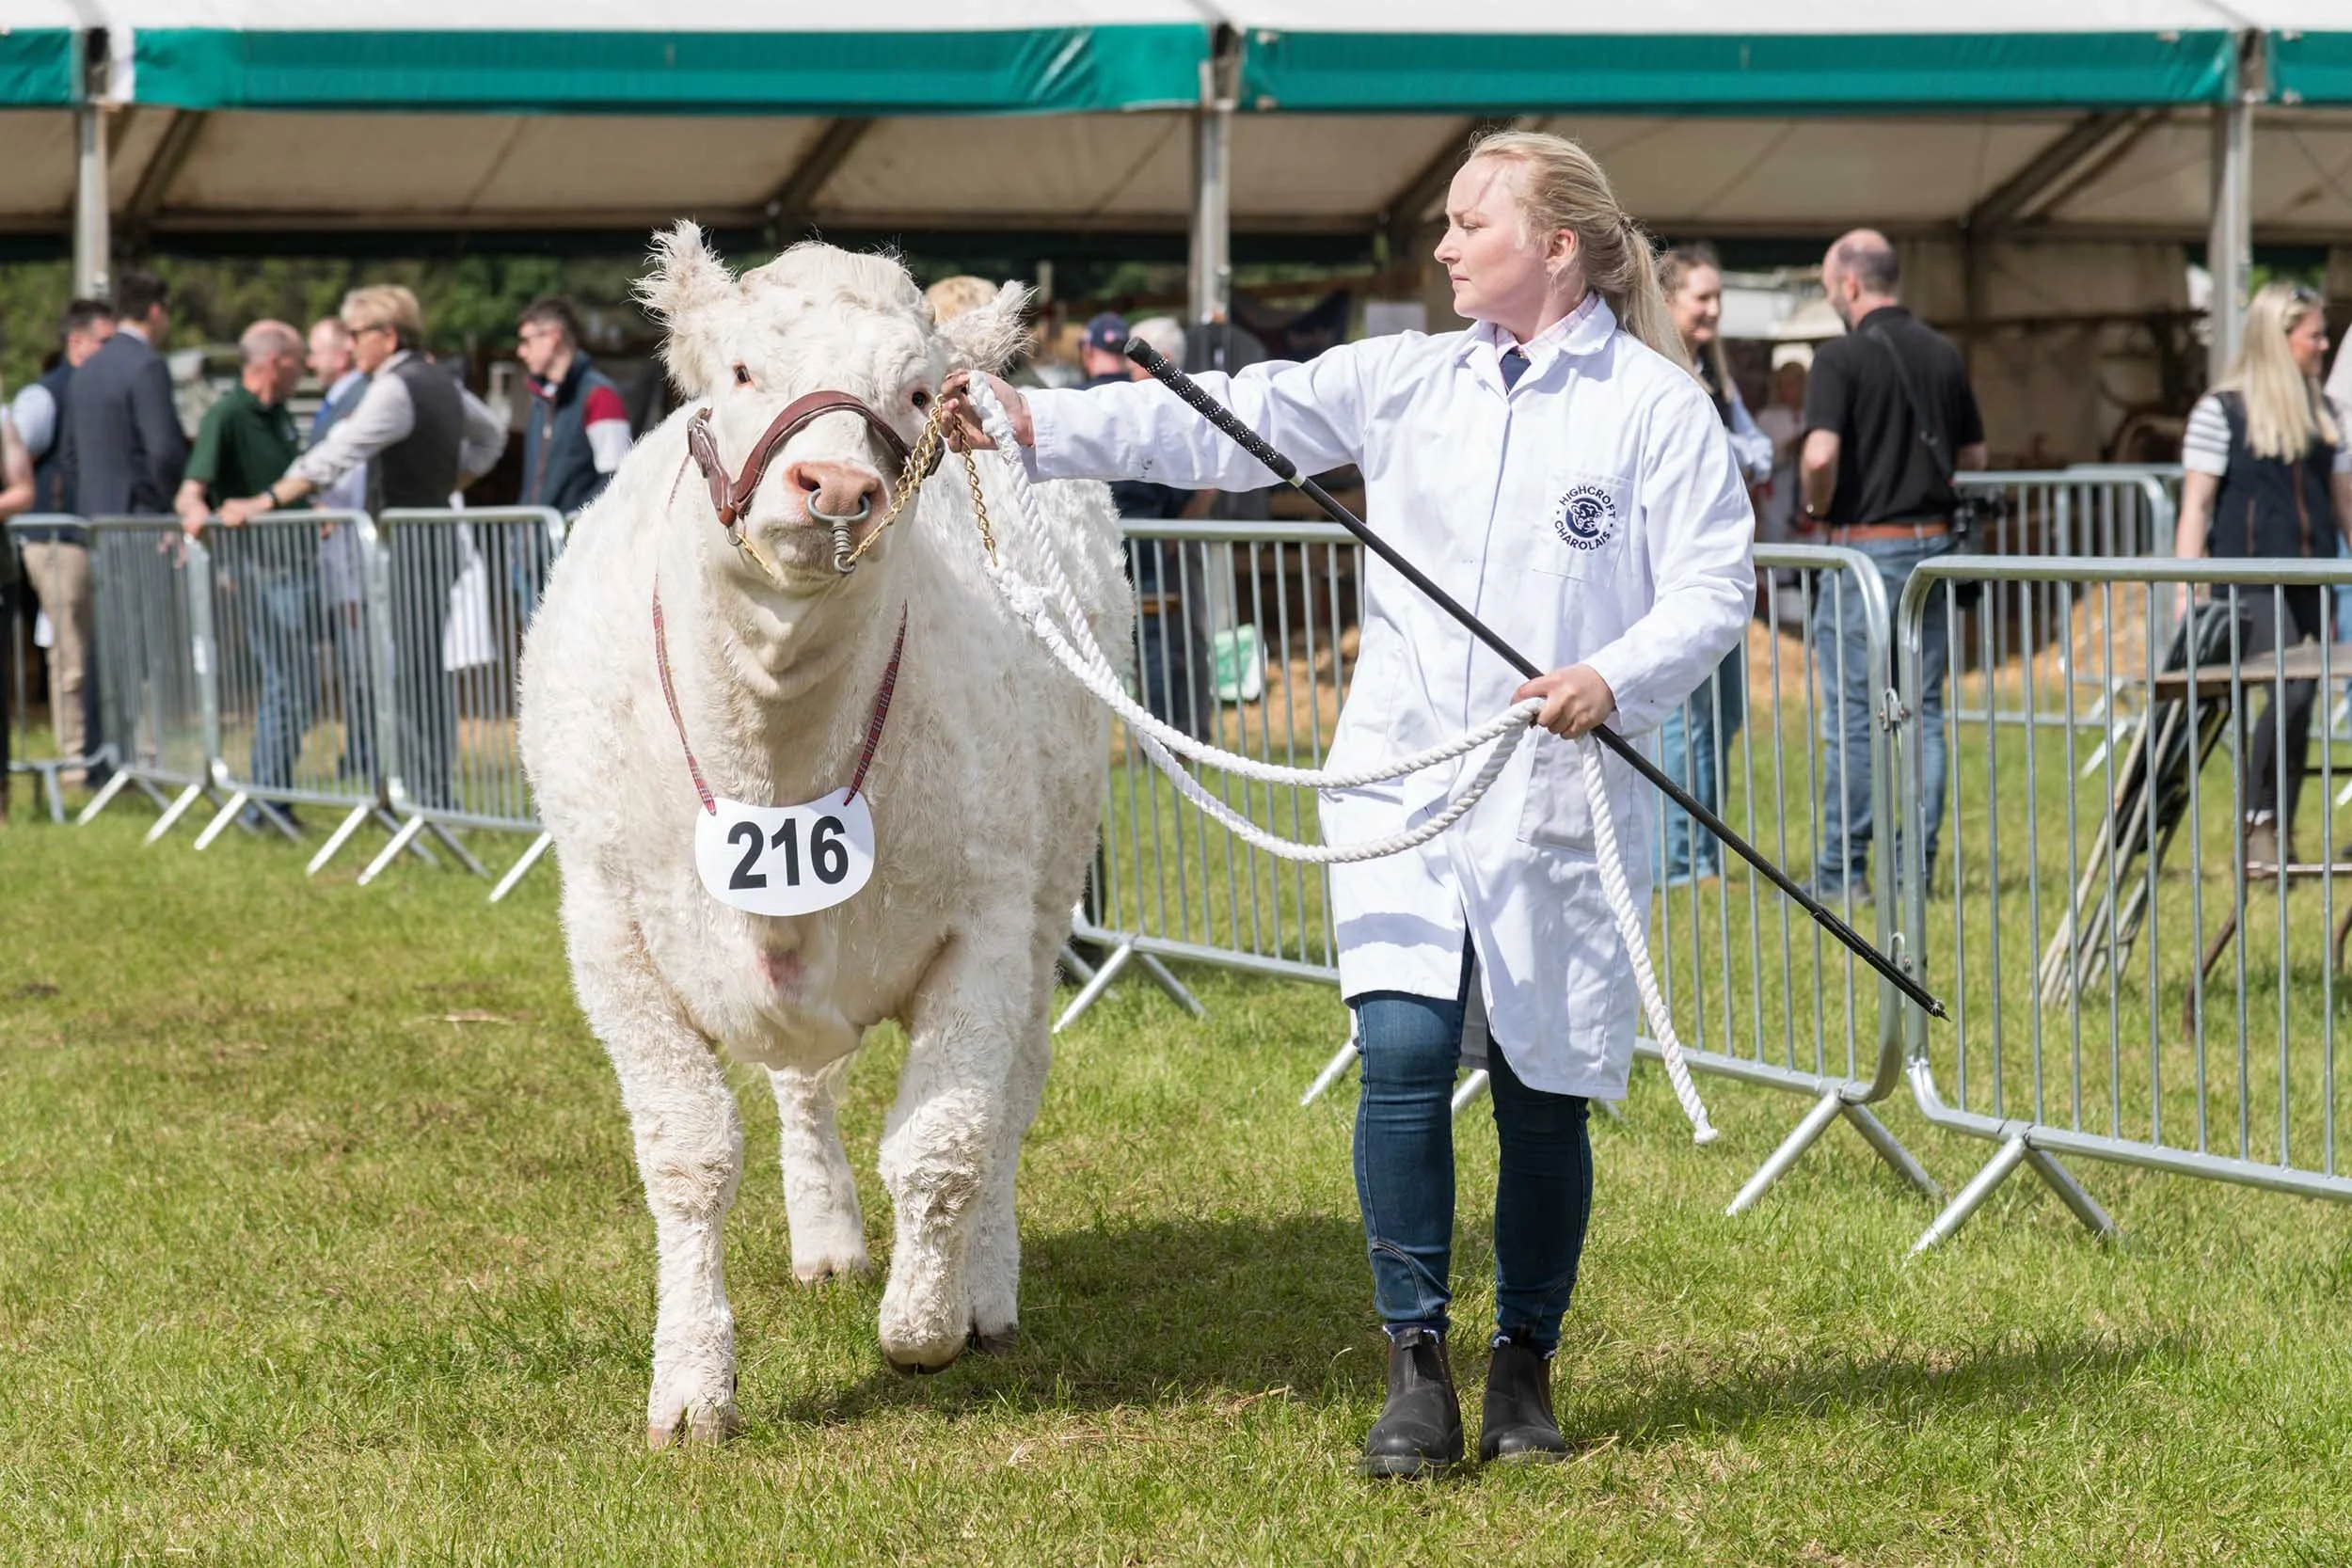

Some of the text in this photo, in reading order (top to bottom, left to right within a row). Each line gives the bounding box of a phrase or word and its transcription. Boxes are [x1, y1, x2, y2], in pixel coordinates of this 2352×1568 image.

[1558, 484, 1616, 519] HIGHCROFT
[1554, 519, 1611, 551] CHAROLAIS
[727, 816, 849, 890] 216
